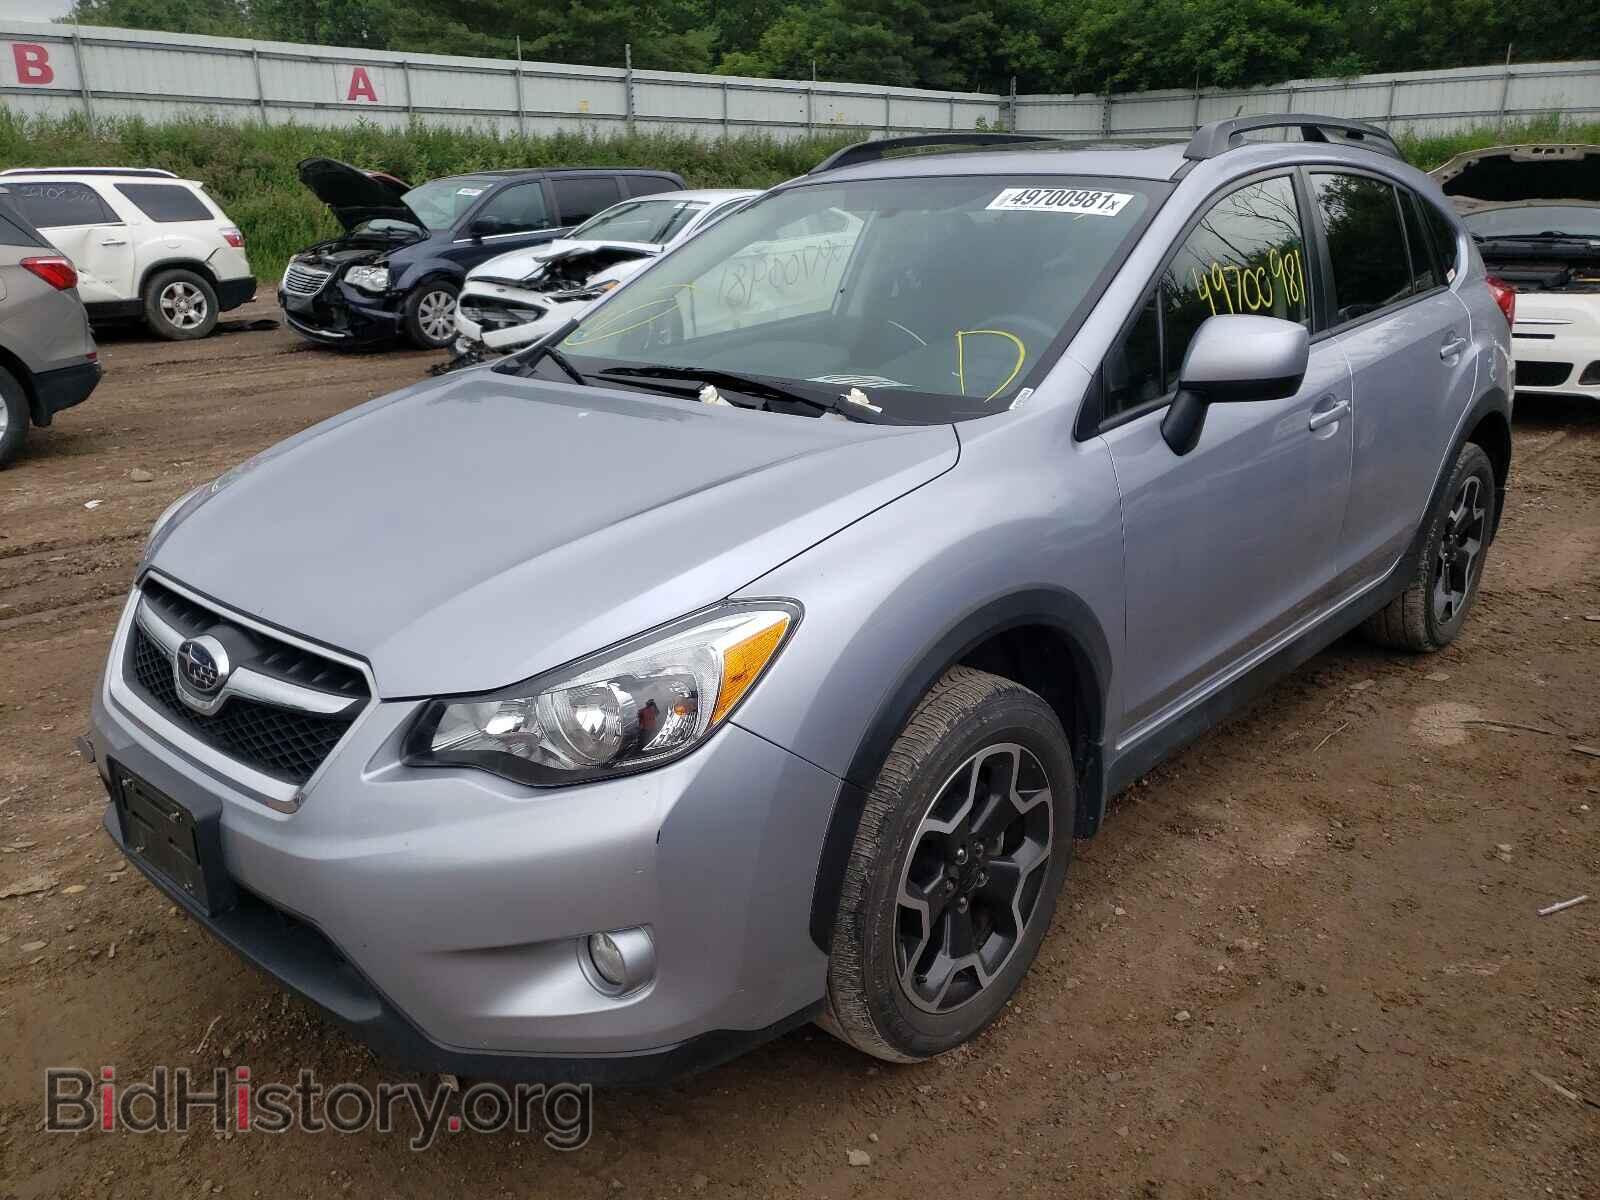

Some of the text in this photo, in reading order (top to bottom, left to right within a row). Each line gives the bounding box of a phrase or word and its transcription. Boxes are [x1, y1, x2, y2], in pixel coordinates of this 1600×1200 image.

[13, 43, 55, 85] B
[346, 67, 378, 102] A
[955, 330, 1026, 403] D
